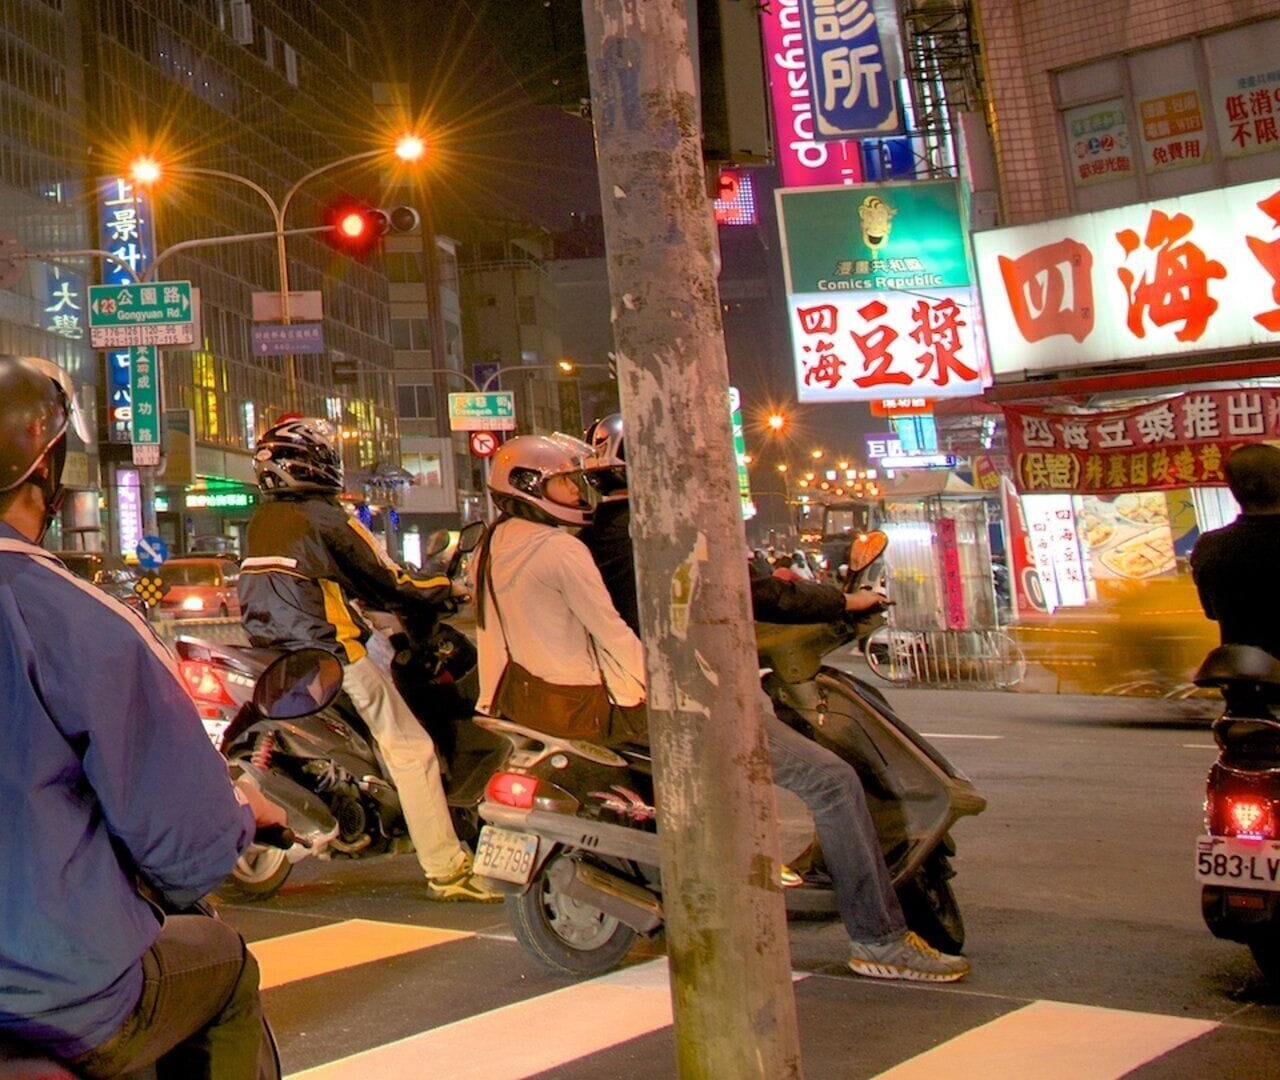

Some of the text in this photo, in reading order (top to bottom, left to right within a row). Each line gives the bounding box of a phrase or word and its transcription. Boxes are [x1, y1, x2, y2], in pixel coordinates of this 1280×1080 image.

[1229, 116, 1279, 148] 不限
[817, 273, 942, 292] Comics Republic
[117, 286, 180, 306] 公園路
[117, 310, 164, 322] Gongyuan
[796, 297, 979, 390] 四海 豆漿
